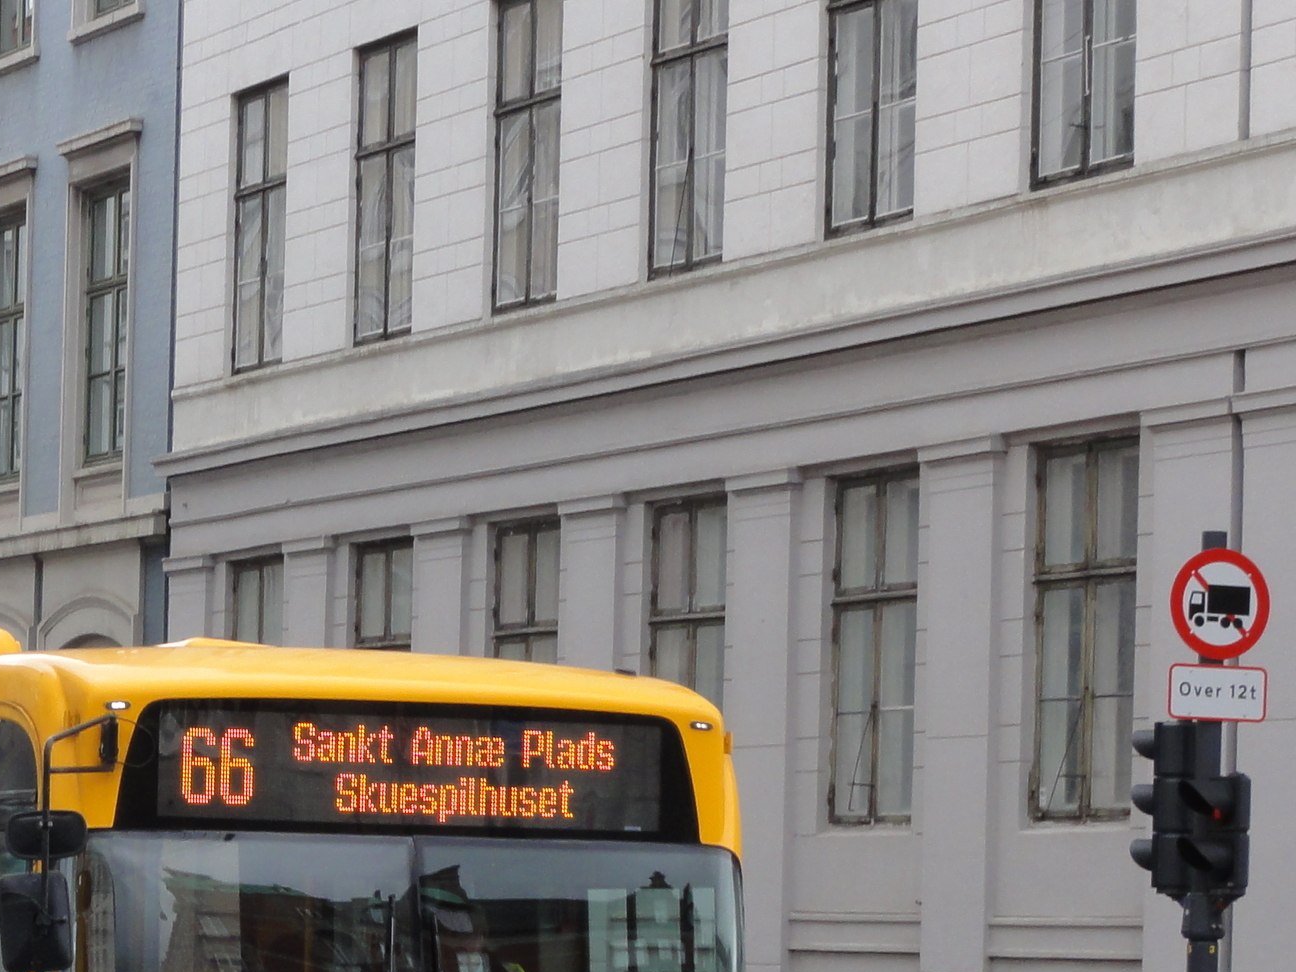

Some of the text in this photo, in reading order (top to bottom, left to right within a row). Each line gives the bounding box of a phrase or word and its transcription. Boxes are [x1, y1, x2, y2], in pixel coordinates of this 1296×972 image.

[1179, 681, 1257, 700] Over 12t
[180, 726, 256, 806] 66
[292, 721, 615, 771] Sankt Annæ Plads
[335, 772, 575, 824] Skuespilhuset
